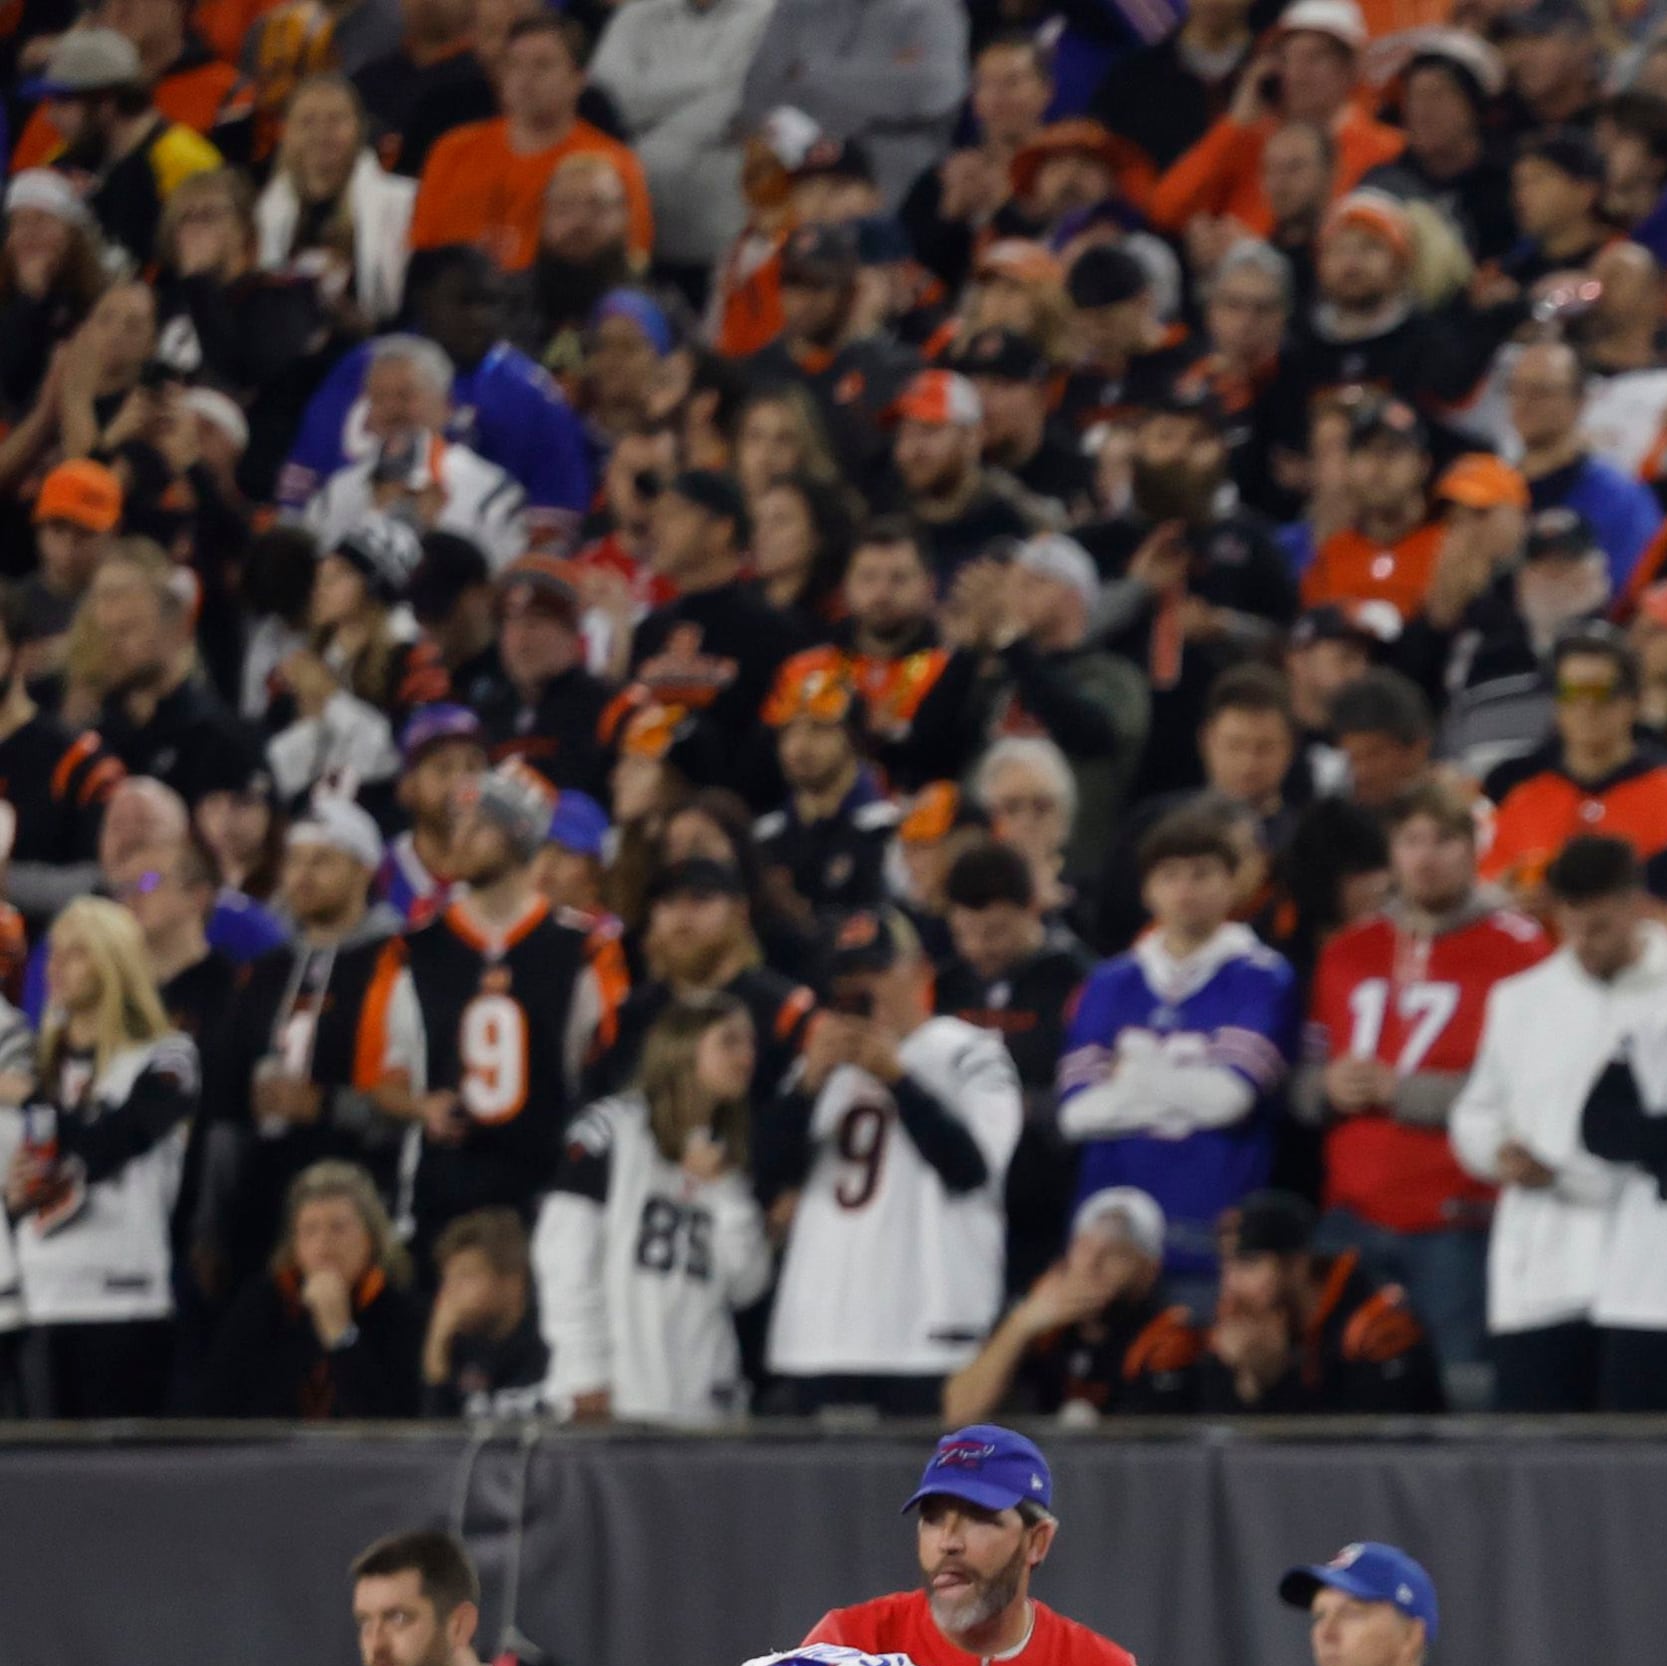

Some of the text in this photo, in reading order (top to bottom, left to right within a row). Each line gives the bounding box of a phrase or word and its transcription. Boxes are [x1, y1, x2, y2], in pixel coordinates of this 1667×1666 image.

[459, 992, 529, 1125] 9
[1349, 976, 1460, 1076] 17
[835, 1105, 888, 1213] 9
[636, 1195, 713, 1281] 85
